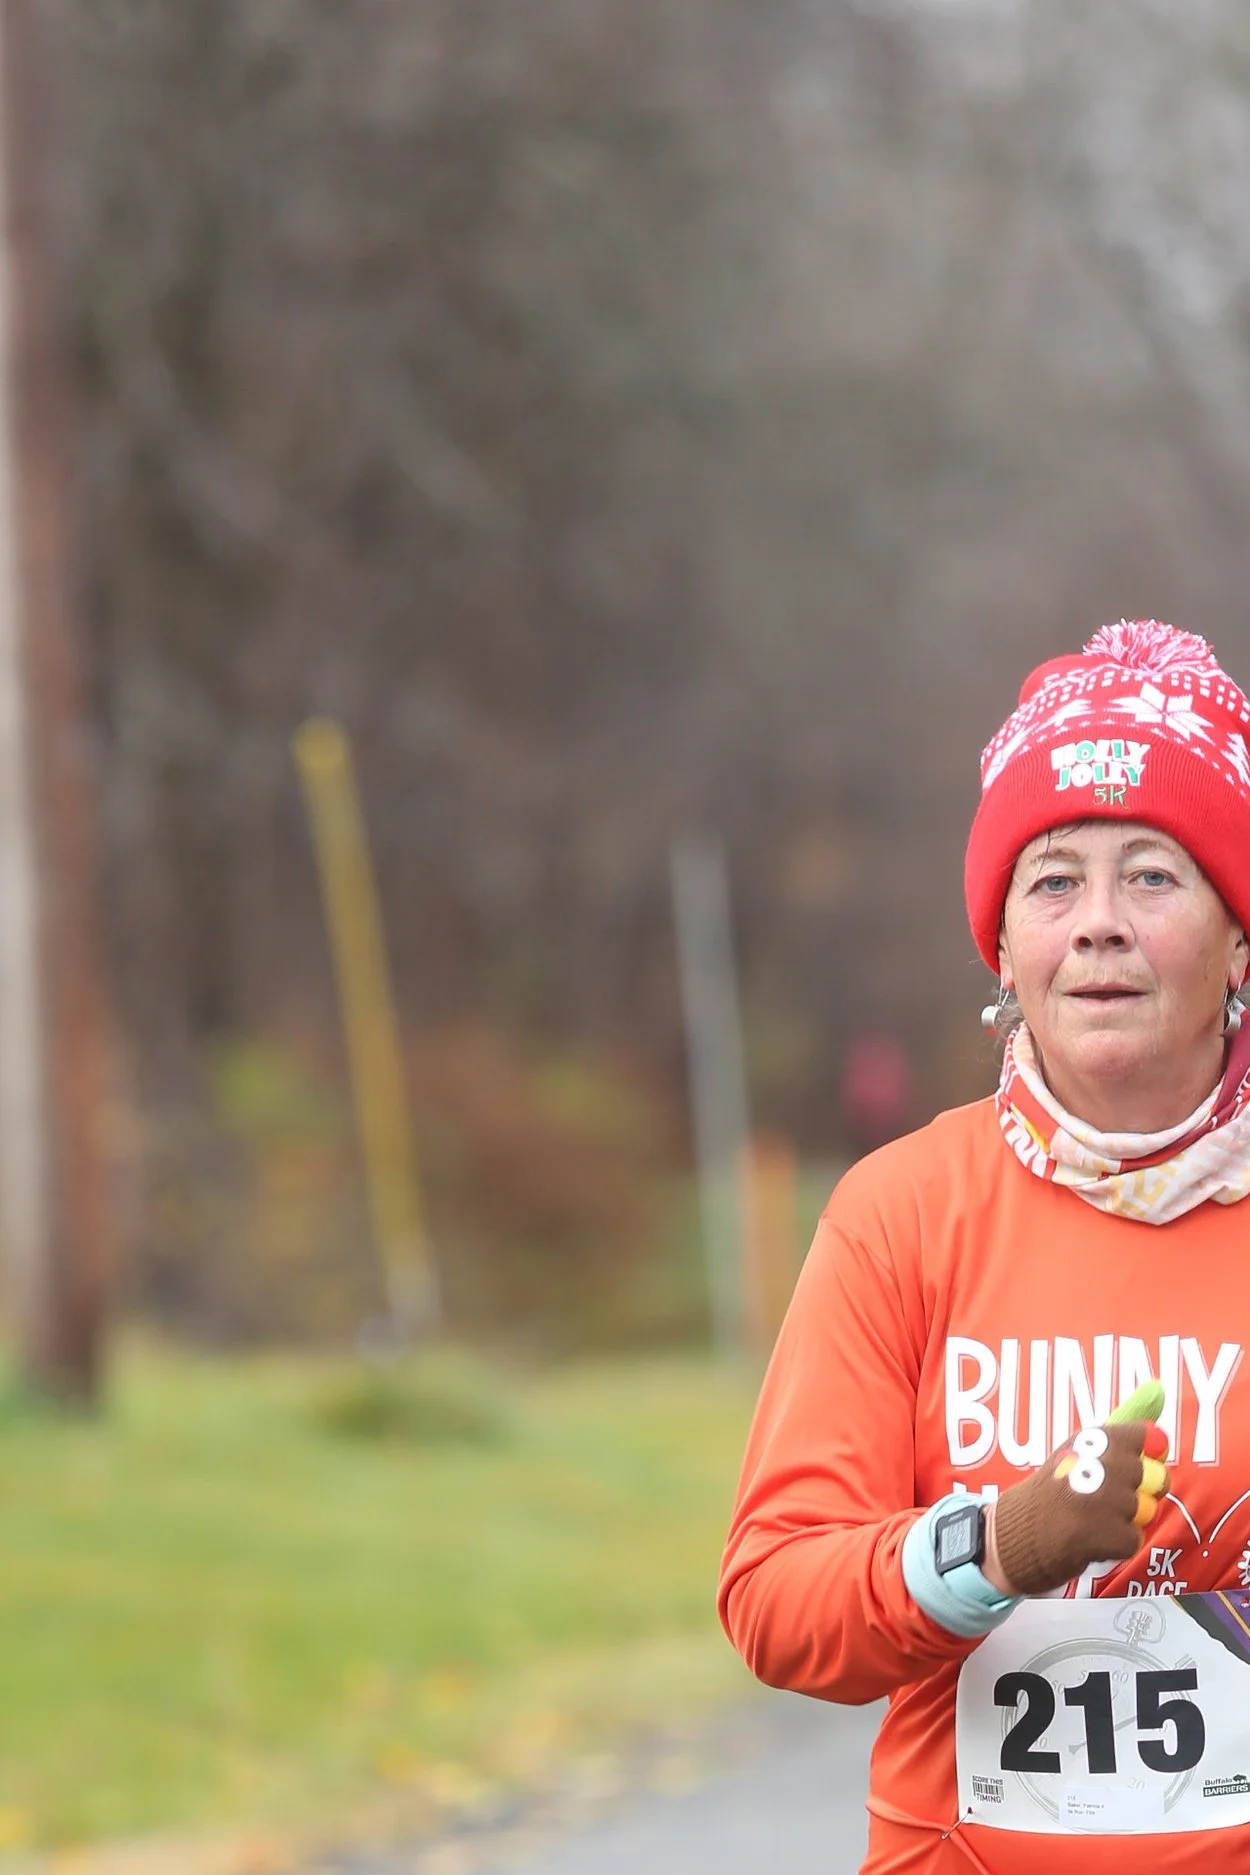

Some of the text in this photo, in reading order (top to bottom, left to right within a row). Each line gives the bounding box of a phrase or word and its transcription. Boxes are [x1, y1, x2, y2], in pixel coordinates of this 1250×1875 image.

[1055, 762, 1146, 791] JOLLY
[1093, 785, 1129, 811] 5K
[945, 1334, 1244, 1467] BUNNY
[1147, 1547, 1183, 1578] 5K
[993, 1668, 1206, 1774] 215
[1204, 1777, 1233, 1786] Buffalo
[1204, 1784, 1249, 1796] BARRIERS
[976, 1793, 1002, 1804] TIMING
